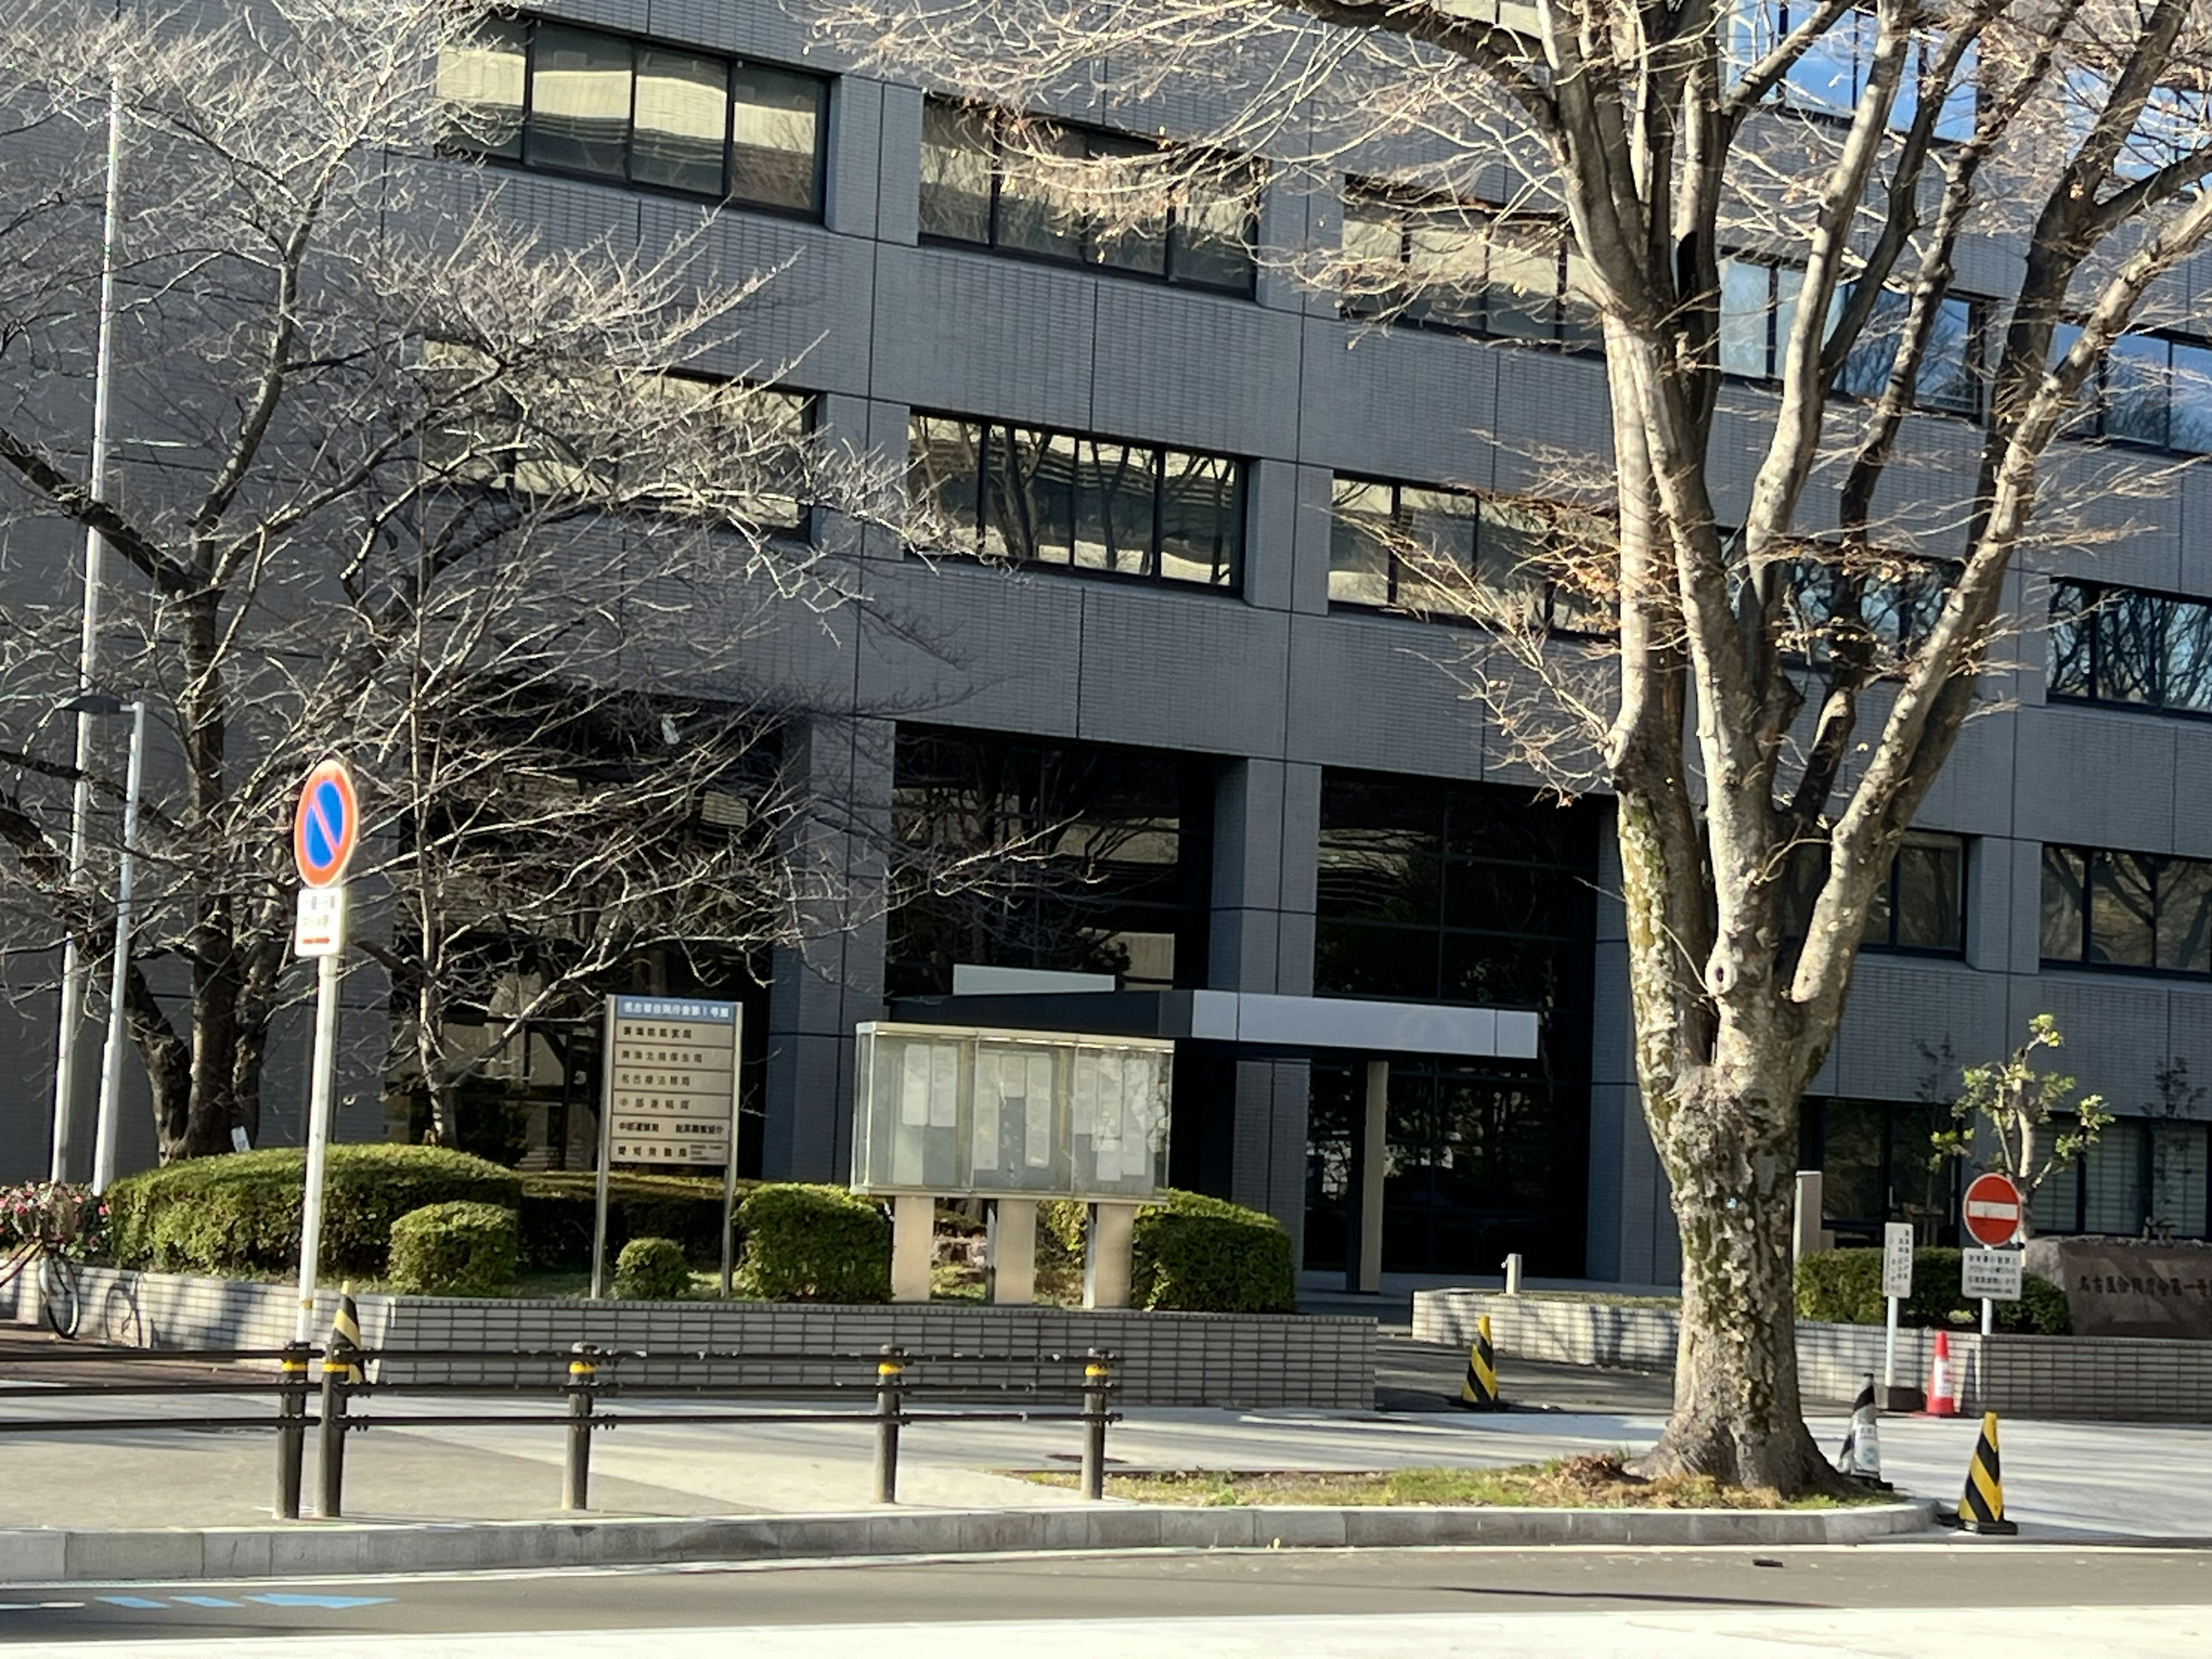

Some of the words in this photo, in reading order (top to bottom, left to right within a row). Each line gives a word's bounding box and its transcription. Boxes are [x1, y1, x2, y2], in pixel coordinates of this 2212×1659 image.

[2078, 1274, 2212, 1297] 名古屋合同庁舎第一号
